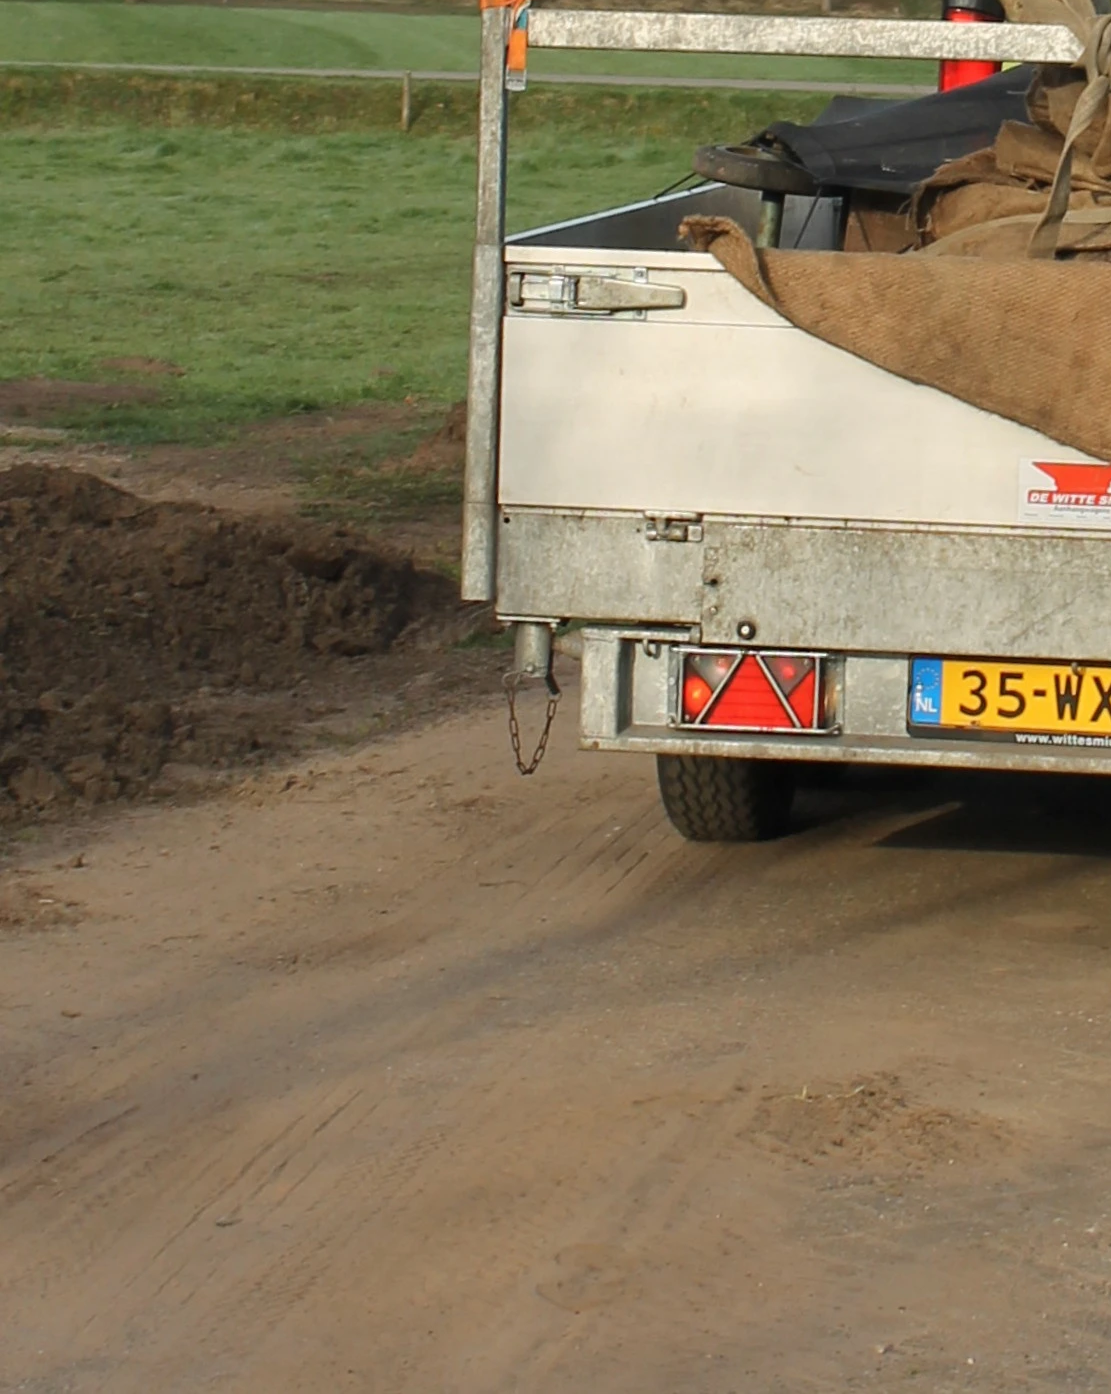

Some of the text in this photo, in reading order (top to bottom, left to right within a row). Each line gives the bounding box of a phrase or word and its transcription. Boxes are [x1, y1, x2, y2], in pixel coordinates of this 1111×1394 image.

[1030, 492, 1048, 503] DE
[1052, 493, 1095, 505] WITTE
[914, 697, 938, 713] NL
